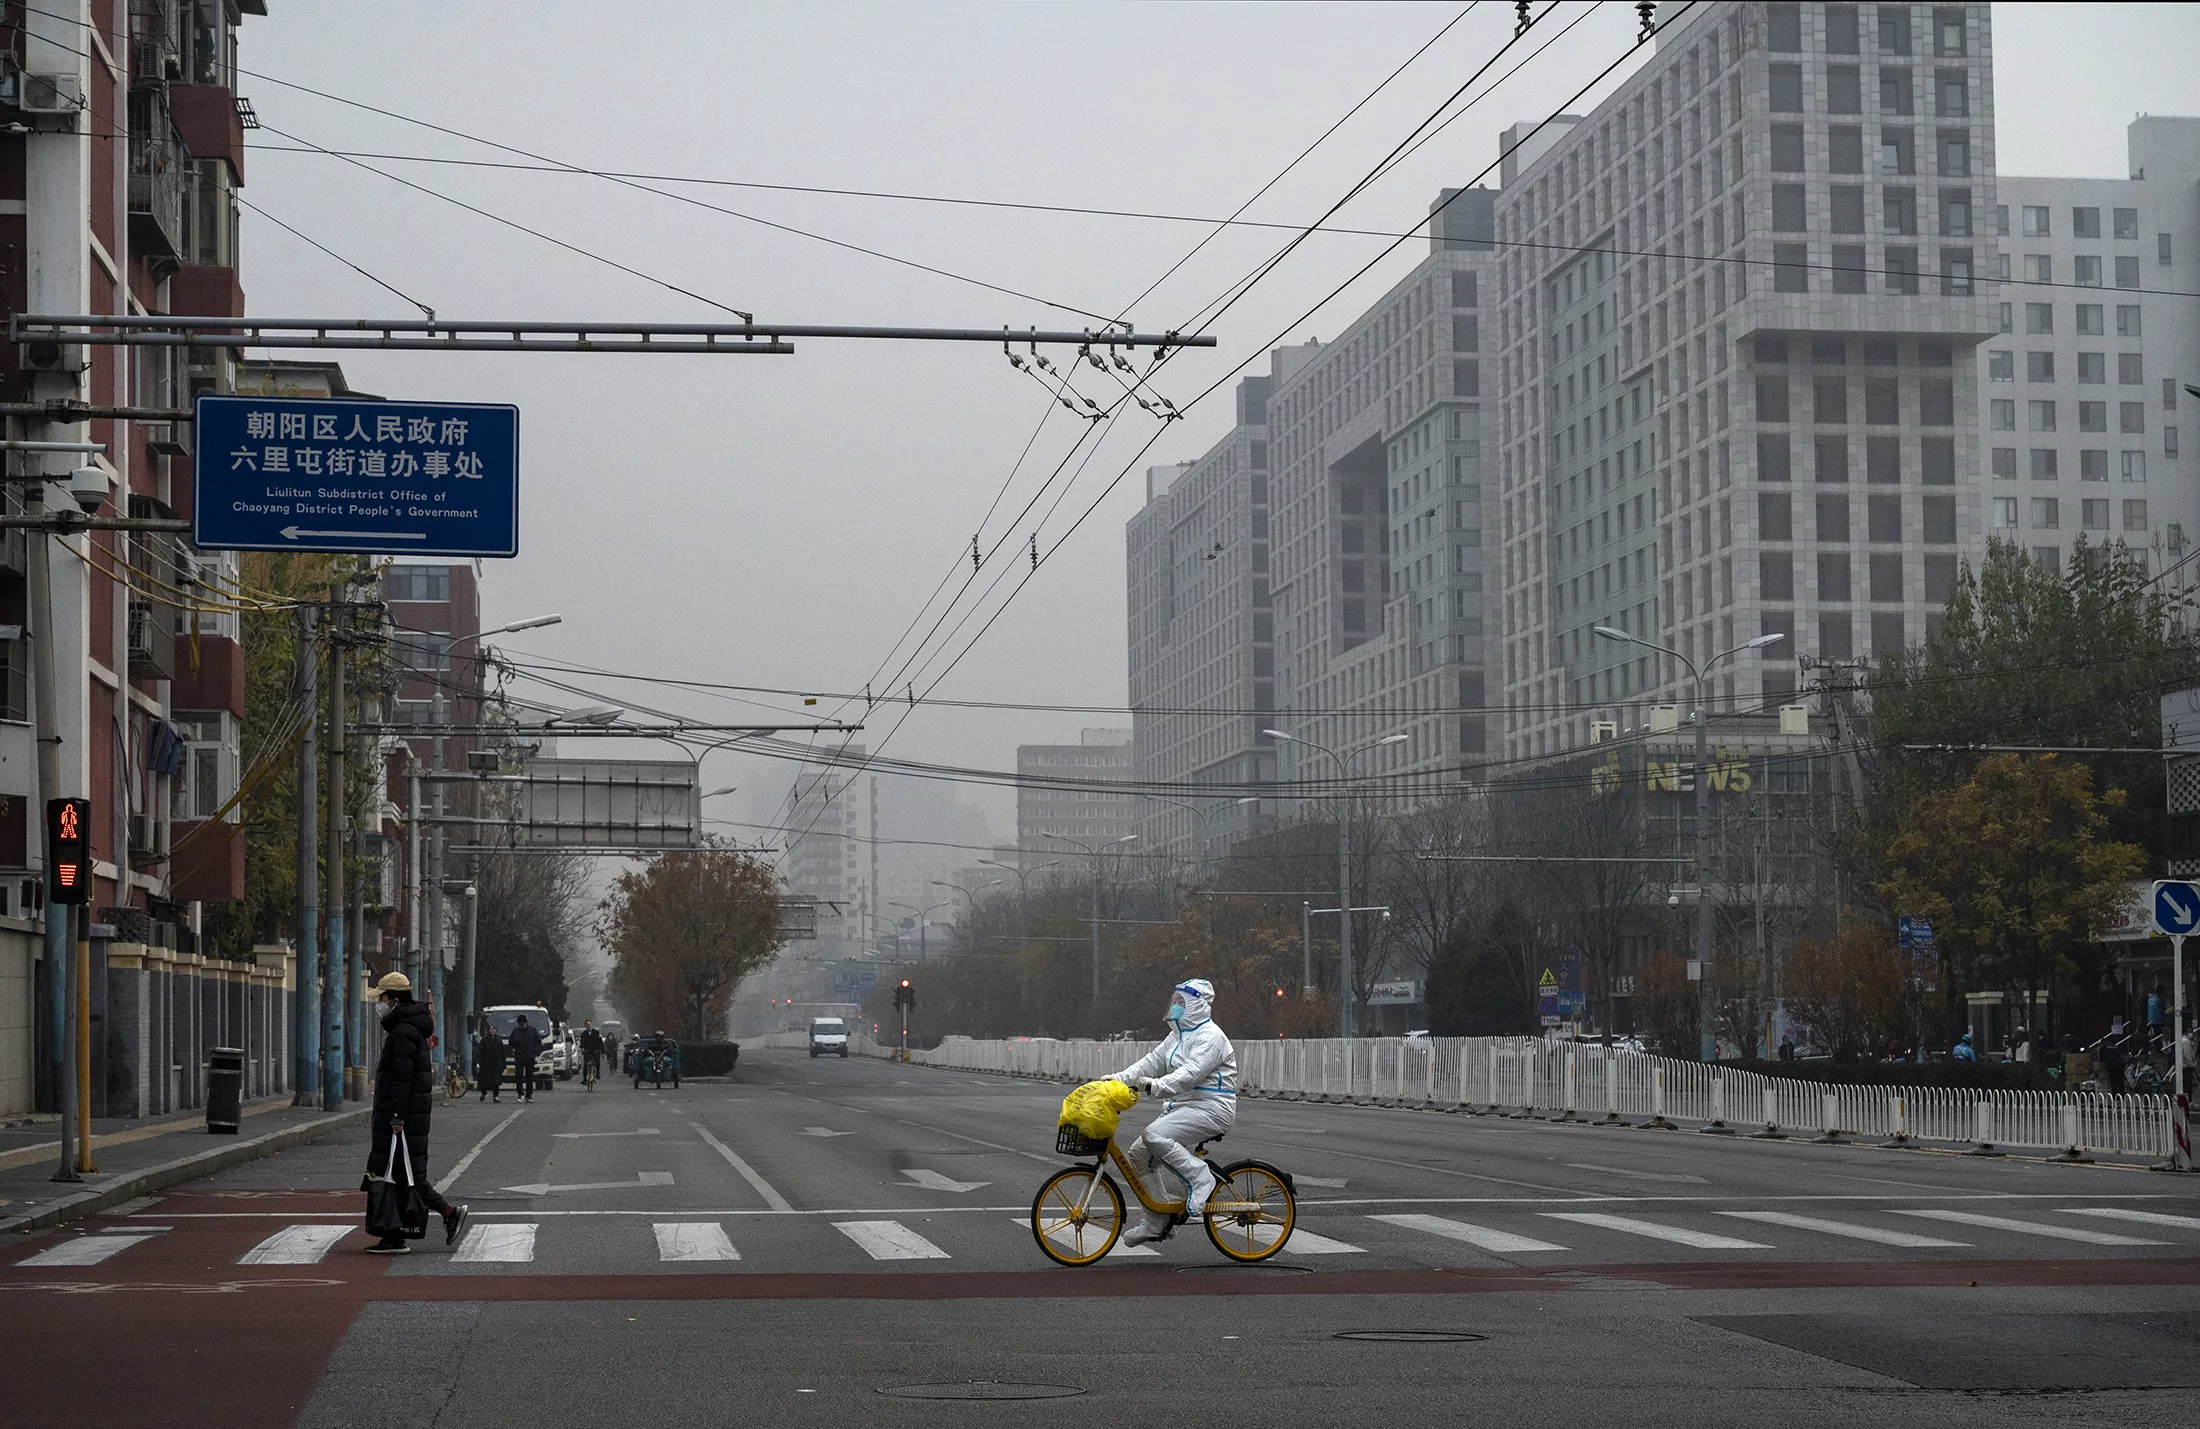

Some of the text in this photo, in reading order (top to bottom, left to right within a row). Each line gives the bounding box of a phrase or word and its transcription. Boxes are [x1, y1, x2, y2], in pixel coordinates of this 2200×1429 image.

[246, 411, 469, 446] 朝阳区人民政府
[230, 446, 484, 479] 六里屯街道办事处
[266, 486, 447, 501] Liulitun Subdistrict Office of
[232, 501, 479, 519] Chaoyang District People's Government
